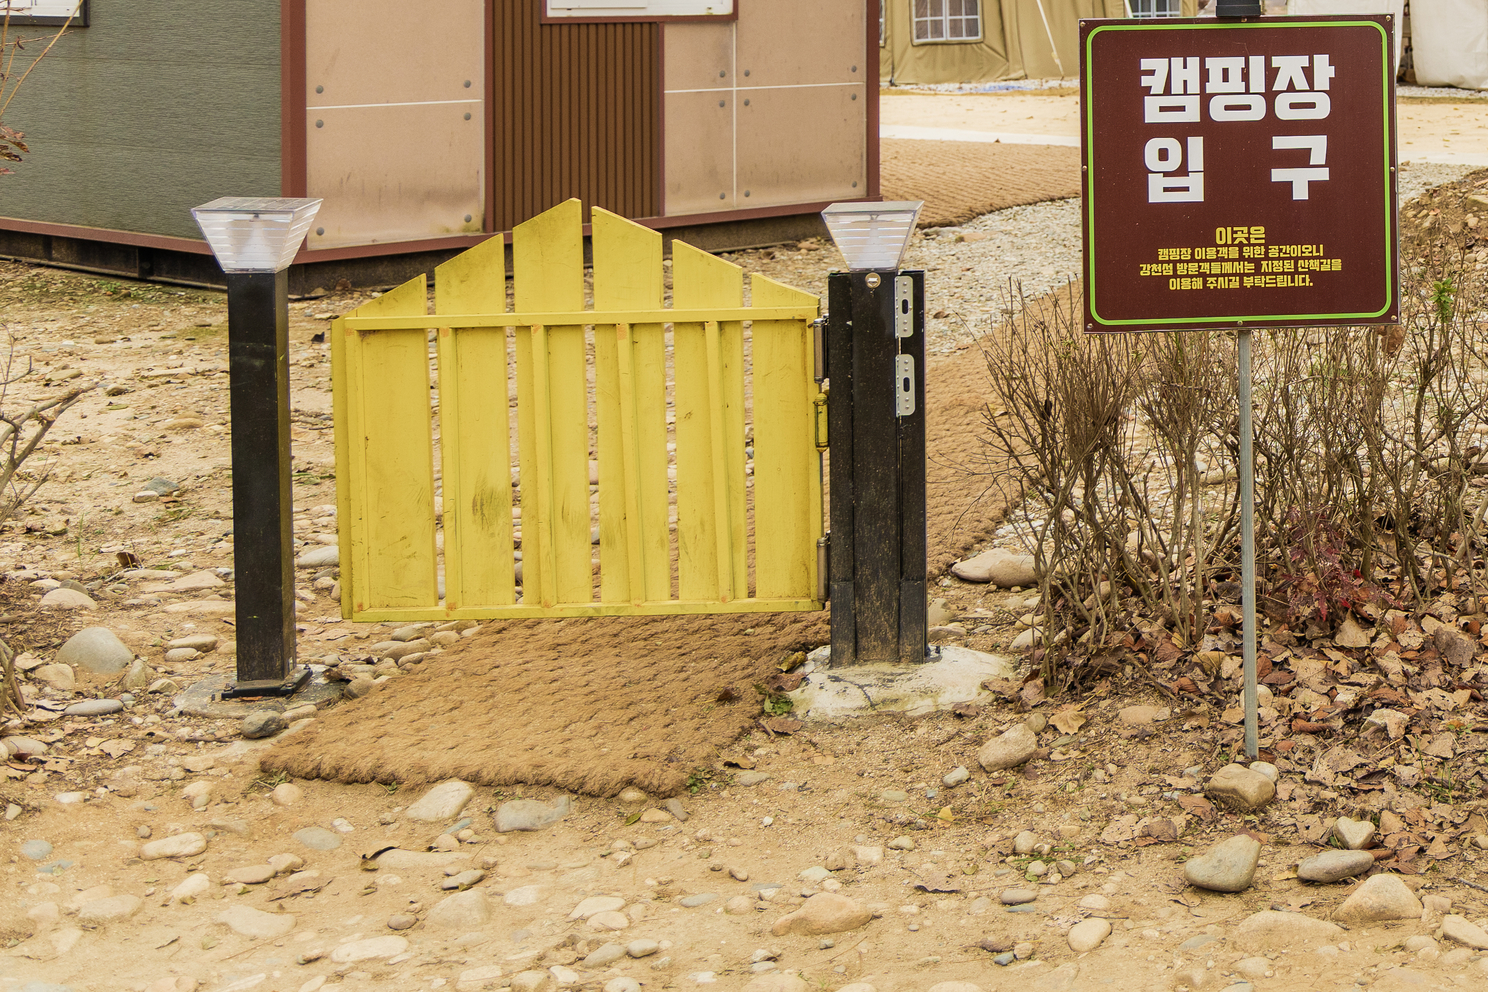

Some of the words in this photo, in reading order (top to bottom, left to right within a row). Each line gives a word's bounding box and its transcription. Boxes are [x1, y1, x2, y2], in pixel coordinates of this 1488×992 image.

[1140, 54, 1335, 123] 캠핑장
[1215, 226, 1266, 245] 이곳은
[1158, 248, 1191, 260] 캠핑장
[1194, 247, 1239, 259] 이용객을
[1243, 246, 1265, 258] 위한
[1268, 244, 1324, 257] 공간이오니
[1140, 263, 1173, 276] 강천섬
[1177, 261, 1255, 275] 방문객들께서는
[1261, 259, 1294, 273] 지정된
[1297, 258, 1342, 272] 산책길을
[1169, 277, 1203, 290] 이용해
[1206, 276, 1240, 289] 주시길
[1243, 274, 1313, 288] 부탁드립니다.
